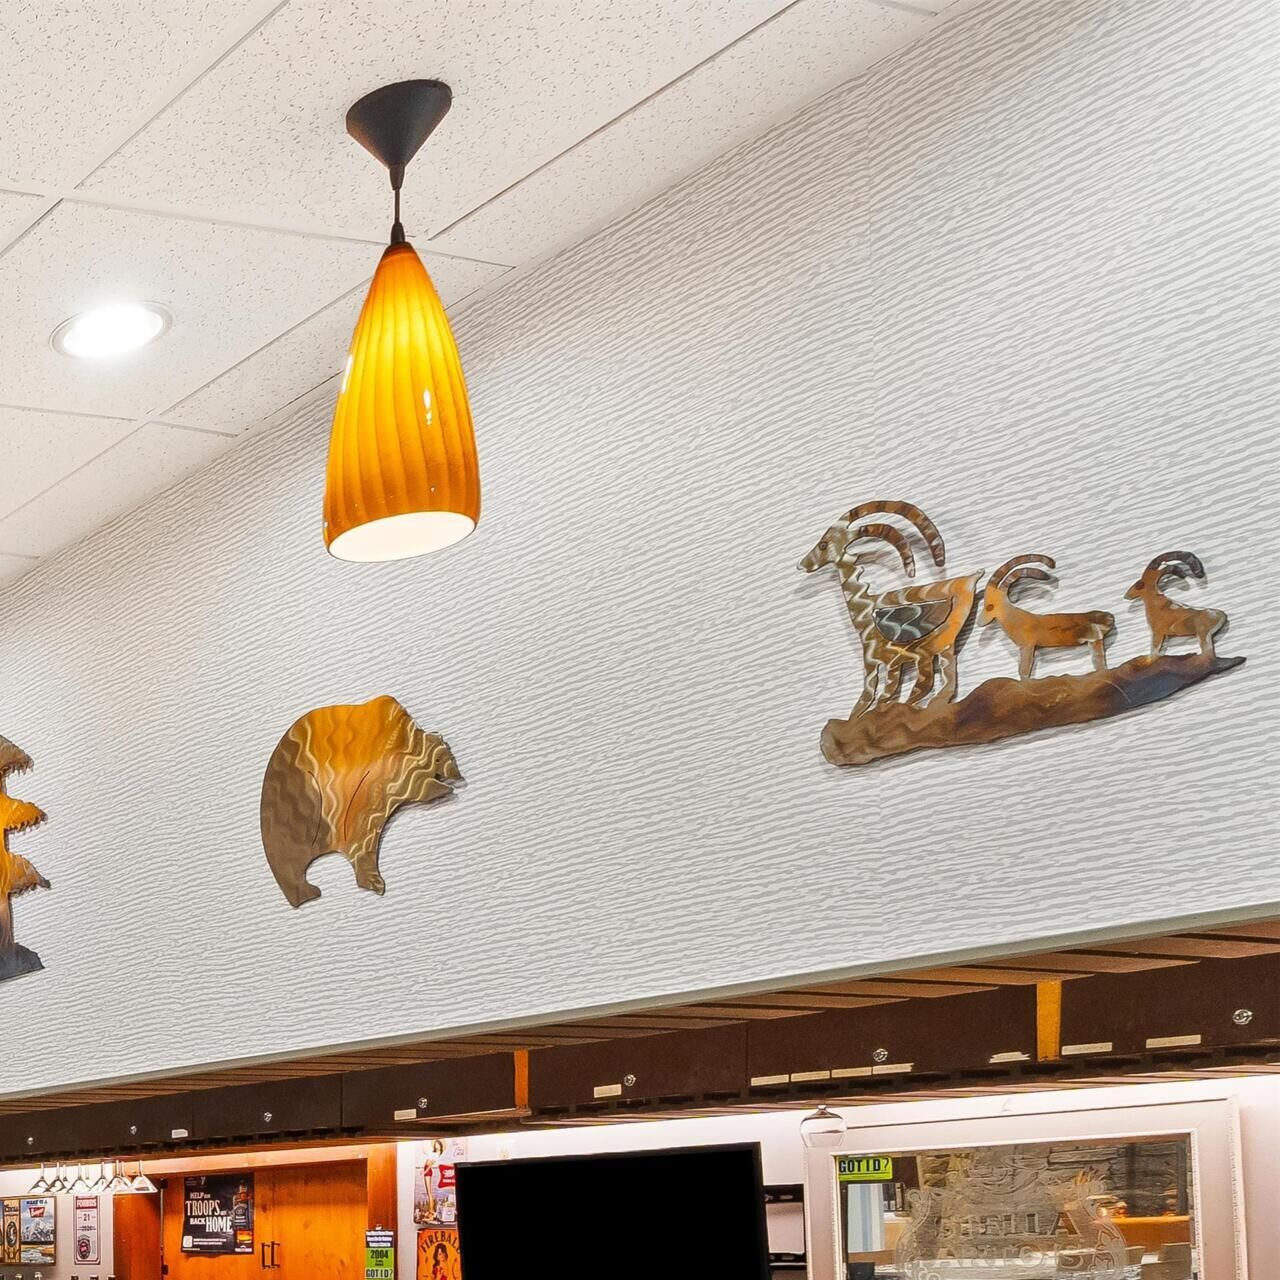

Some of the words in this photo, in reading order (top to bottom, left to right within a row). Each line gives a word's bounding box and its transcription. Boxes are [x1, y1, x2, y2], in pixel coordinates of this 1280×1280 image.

[839, 1159, 862, 1173] GOT
[185, 1200, 220, 1216] TROOPS
[189, 1217, 206, 1225] BACK
[206, 1216, 233, 1232] HOME
[370, 1249, 389, 1259] 2004
[366, 1268, 378, 1278] GOT
